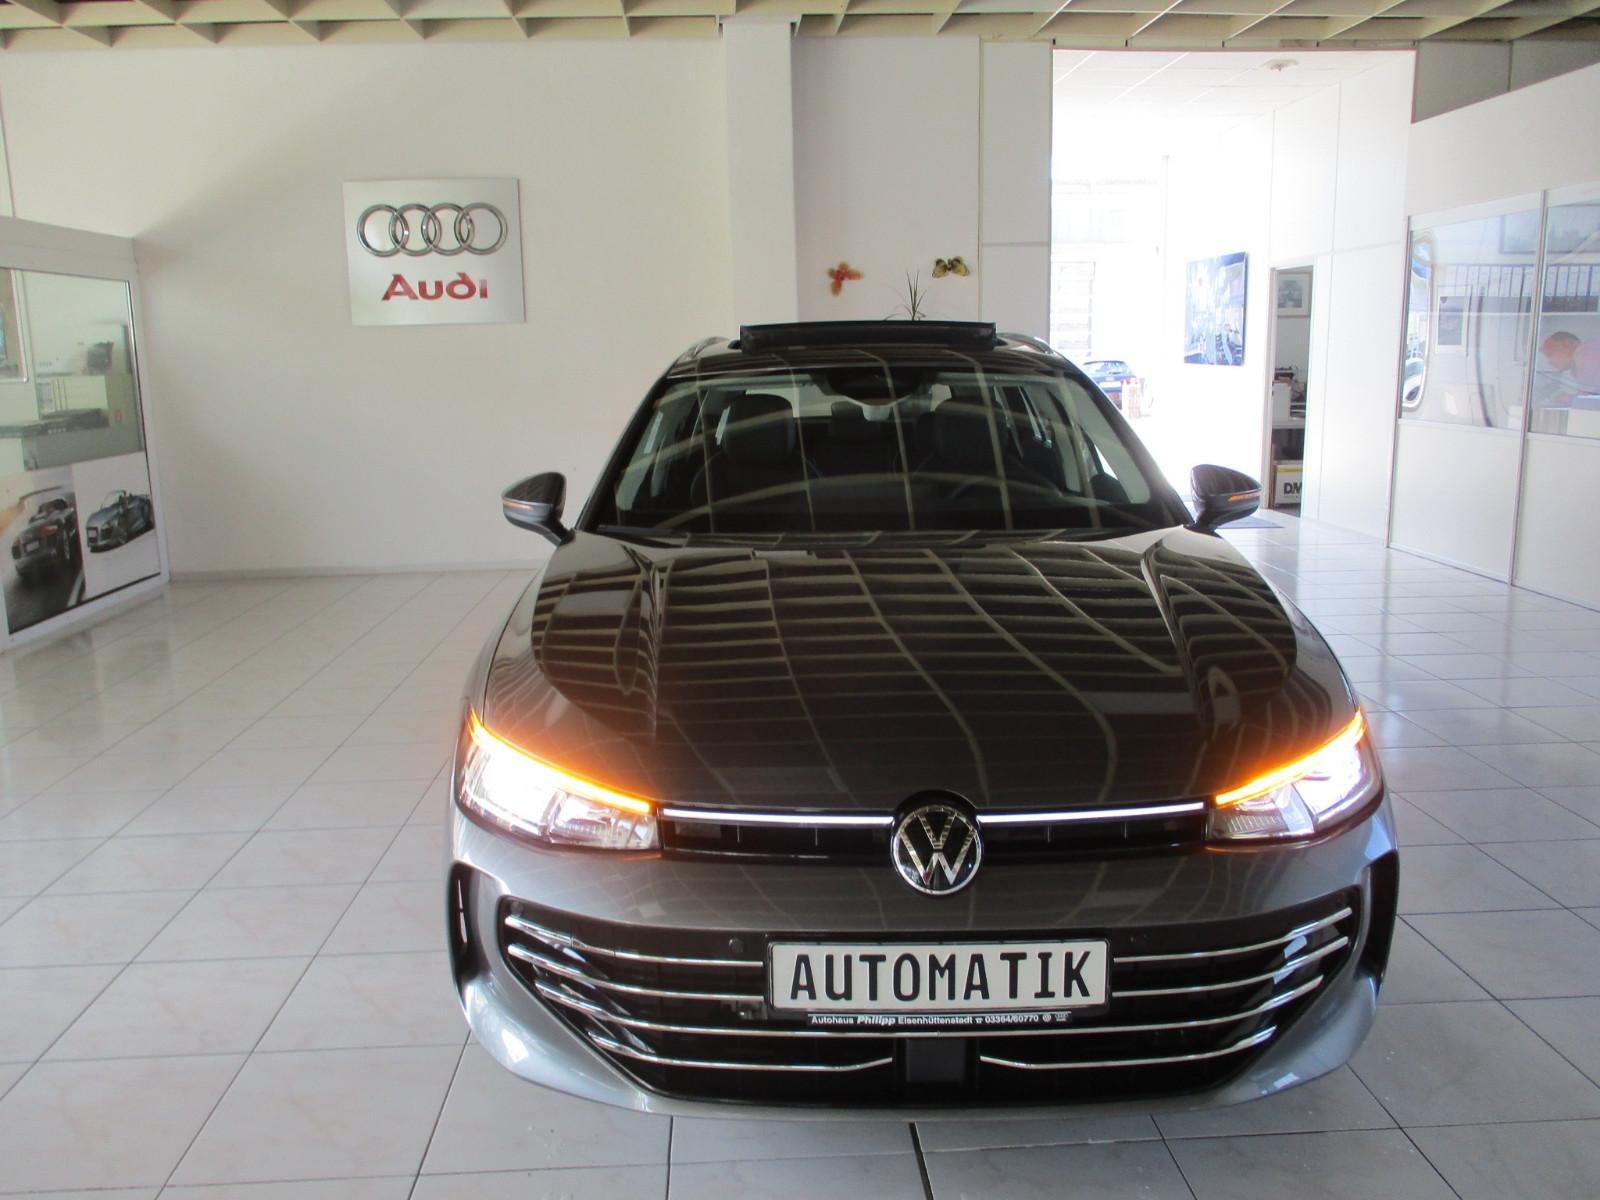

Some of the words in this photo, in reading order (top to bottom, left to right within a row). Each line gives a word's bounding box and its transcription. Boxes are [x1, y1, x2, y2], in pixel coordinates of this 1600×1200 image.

[382, 272, 488, 301] Audi
[790, 951, 1091, 1001] AUTOMATIK
[811, 1015, 854, 1025] Autohaus
[857, 1015, 896, 1026] Philipp
[898, 1014, 973, 1025] Eisenhüttenstadt
[985, 1014, 1039, 1024] 03364/60770
